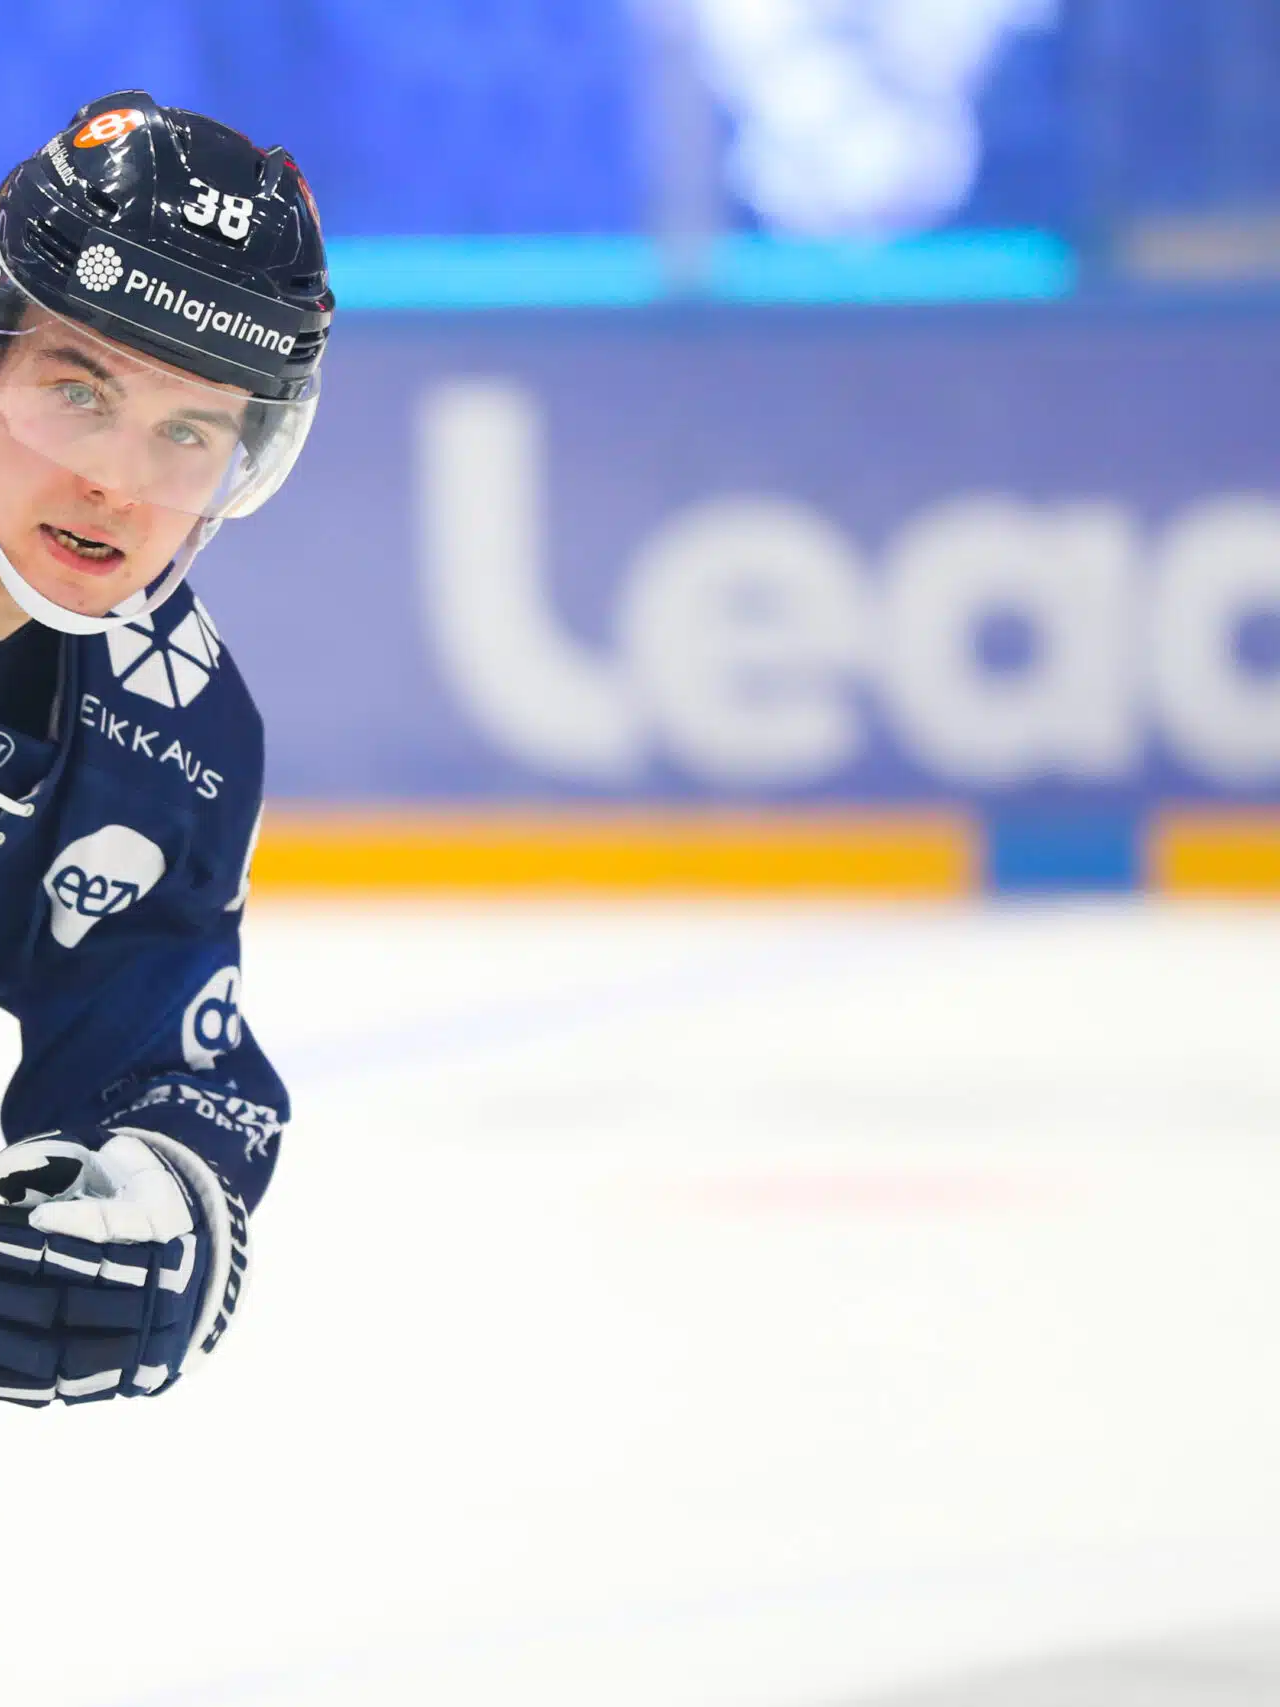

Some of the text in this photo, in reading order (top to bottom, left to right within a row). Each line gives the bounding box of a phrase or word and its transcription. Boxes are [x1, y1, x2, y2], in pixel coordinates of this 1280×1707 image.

[182, 177, 254, 241] 38
[124, 269, 296, 357] Pihlajalinna
[80, 693, 224, 799] EIKKAUS
